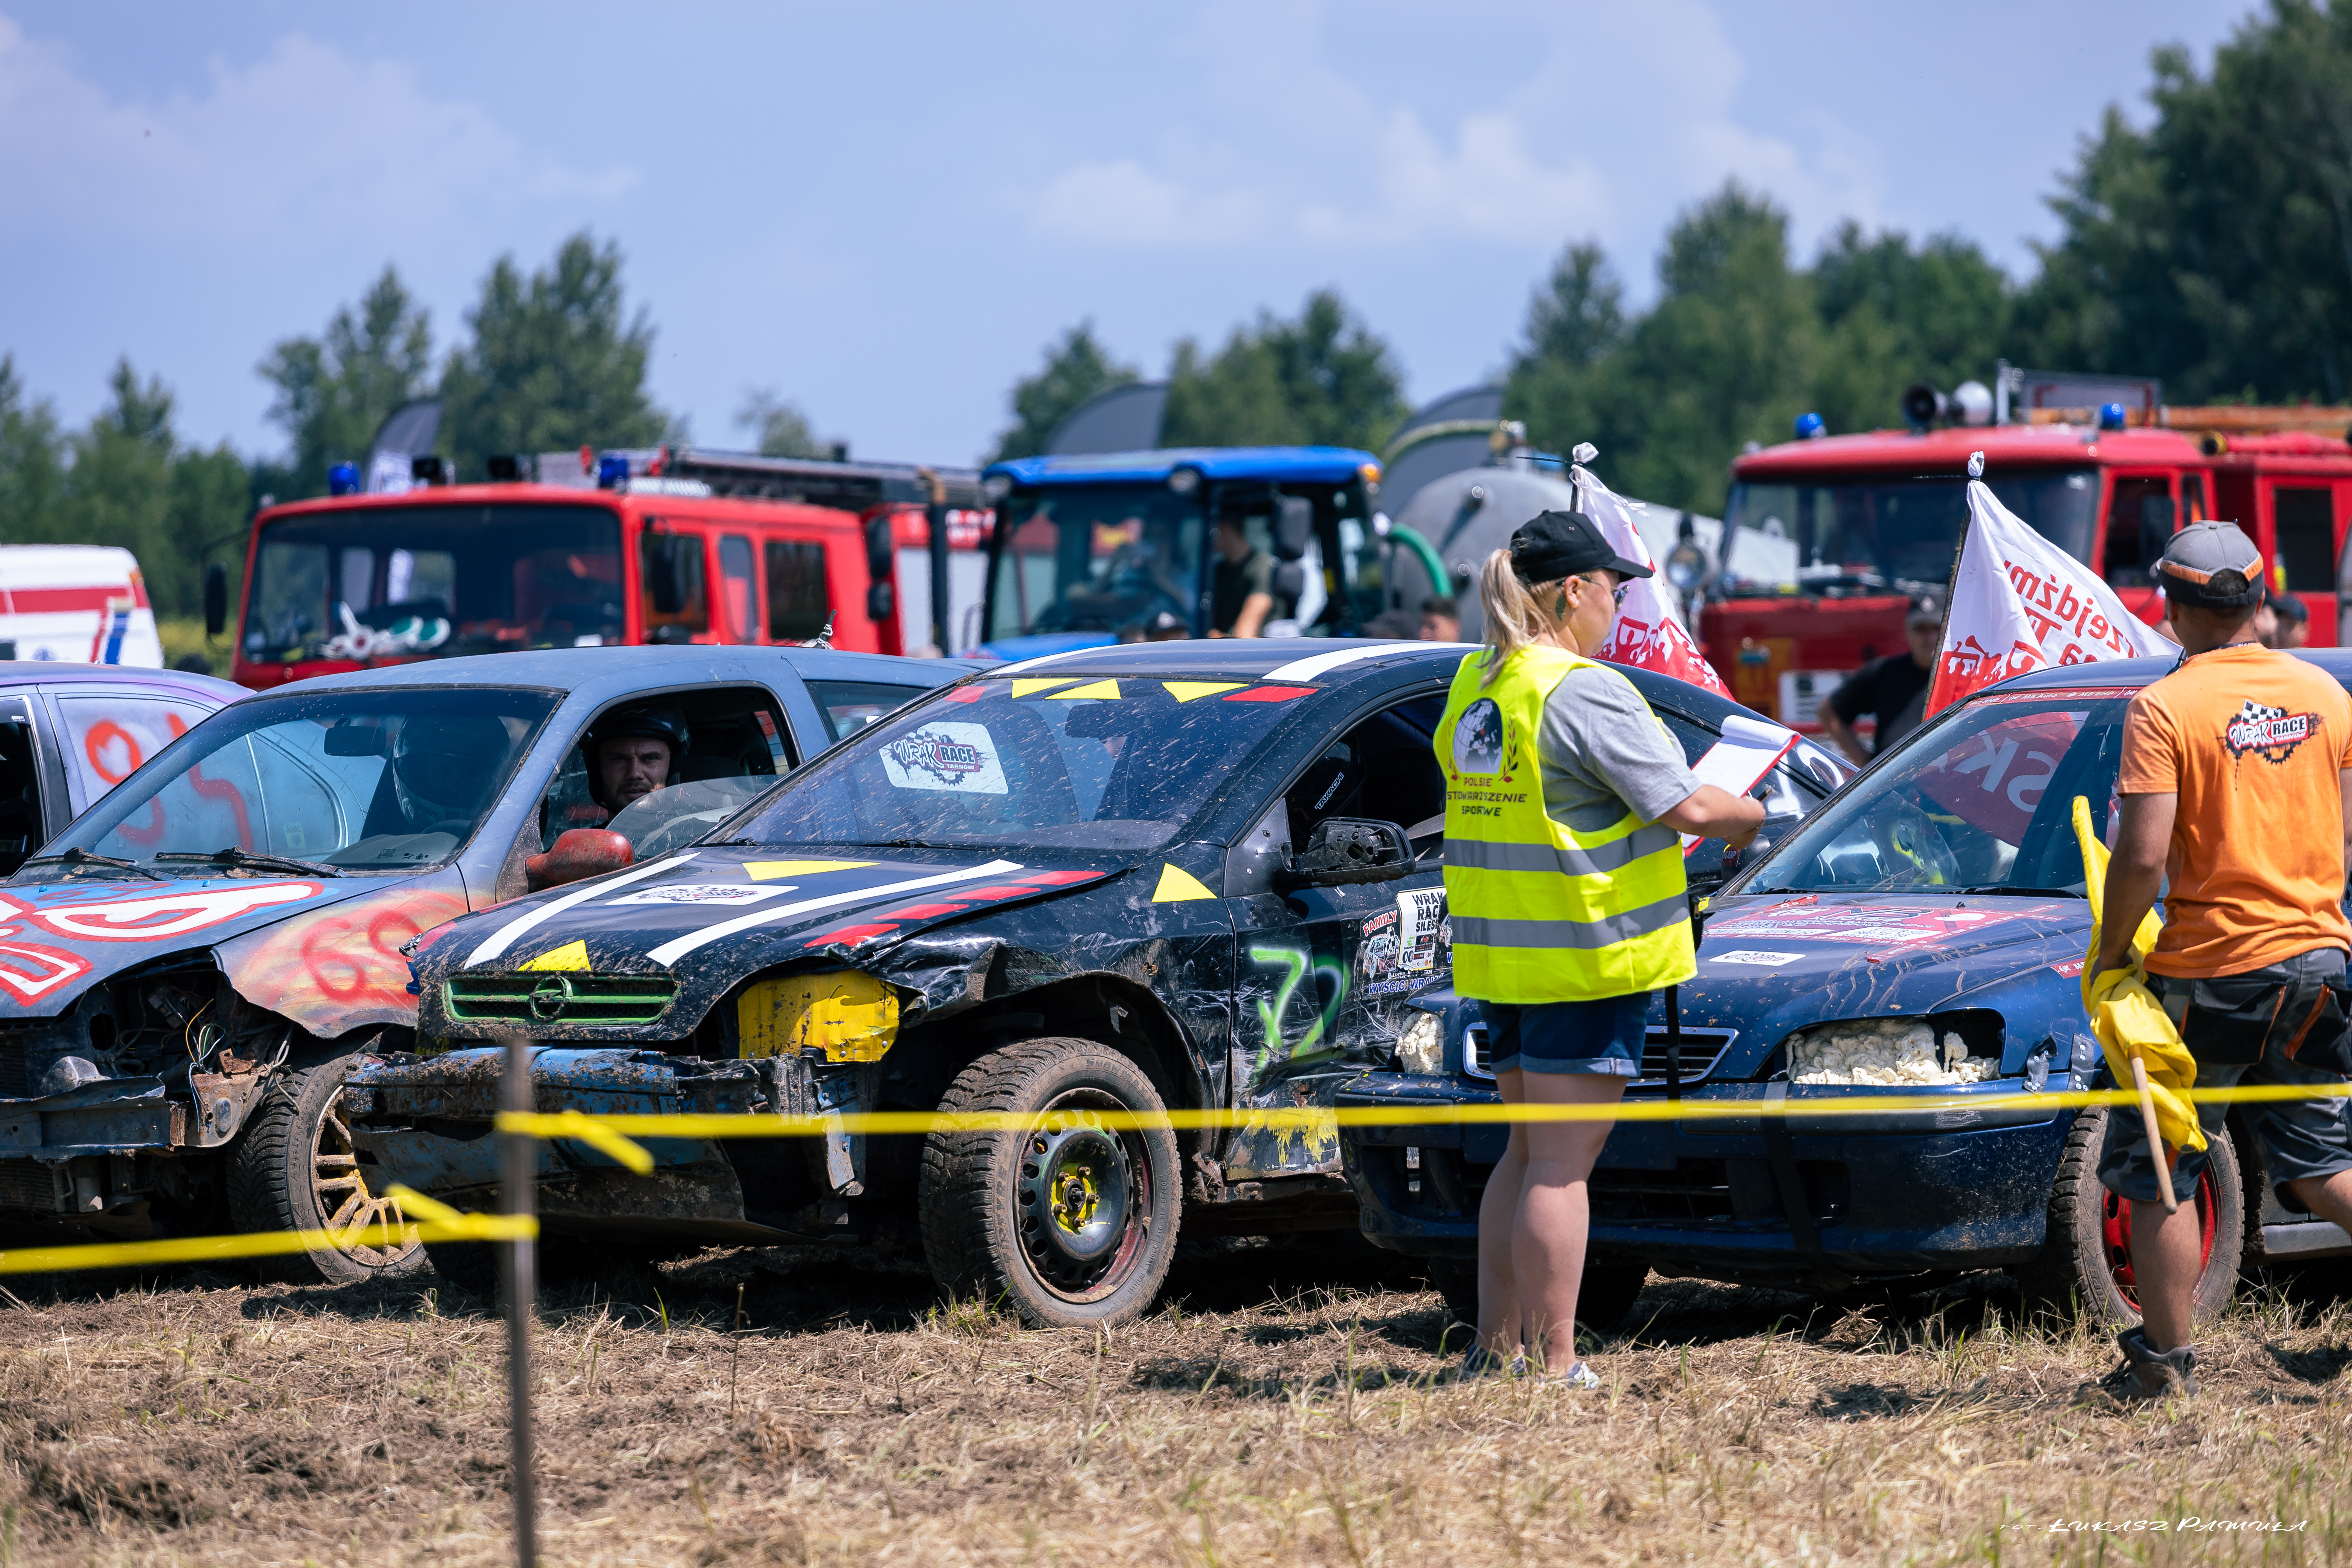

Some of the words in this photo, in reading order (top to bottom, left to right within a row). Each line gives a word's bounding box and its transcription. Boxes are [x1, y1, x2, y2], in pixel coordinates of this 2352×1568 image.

[2229, 720, 2274, 747] WRAK
[2272, 716, 2307, 737] RACE
[893, 739, 945, 768] WRAK
[939, 744, 976, 764] RACE
[1314, 772, 1344, 809] TAKACHI
[1362, 910, 1398, 937] FAMILY
[1369, 979, 1408, 995] WYŚCIGI
[1145, 1245, 1158, 1267] RADIAL
